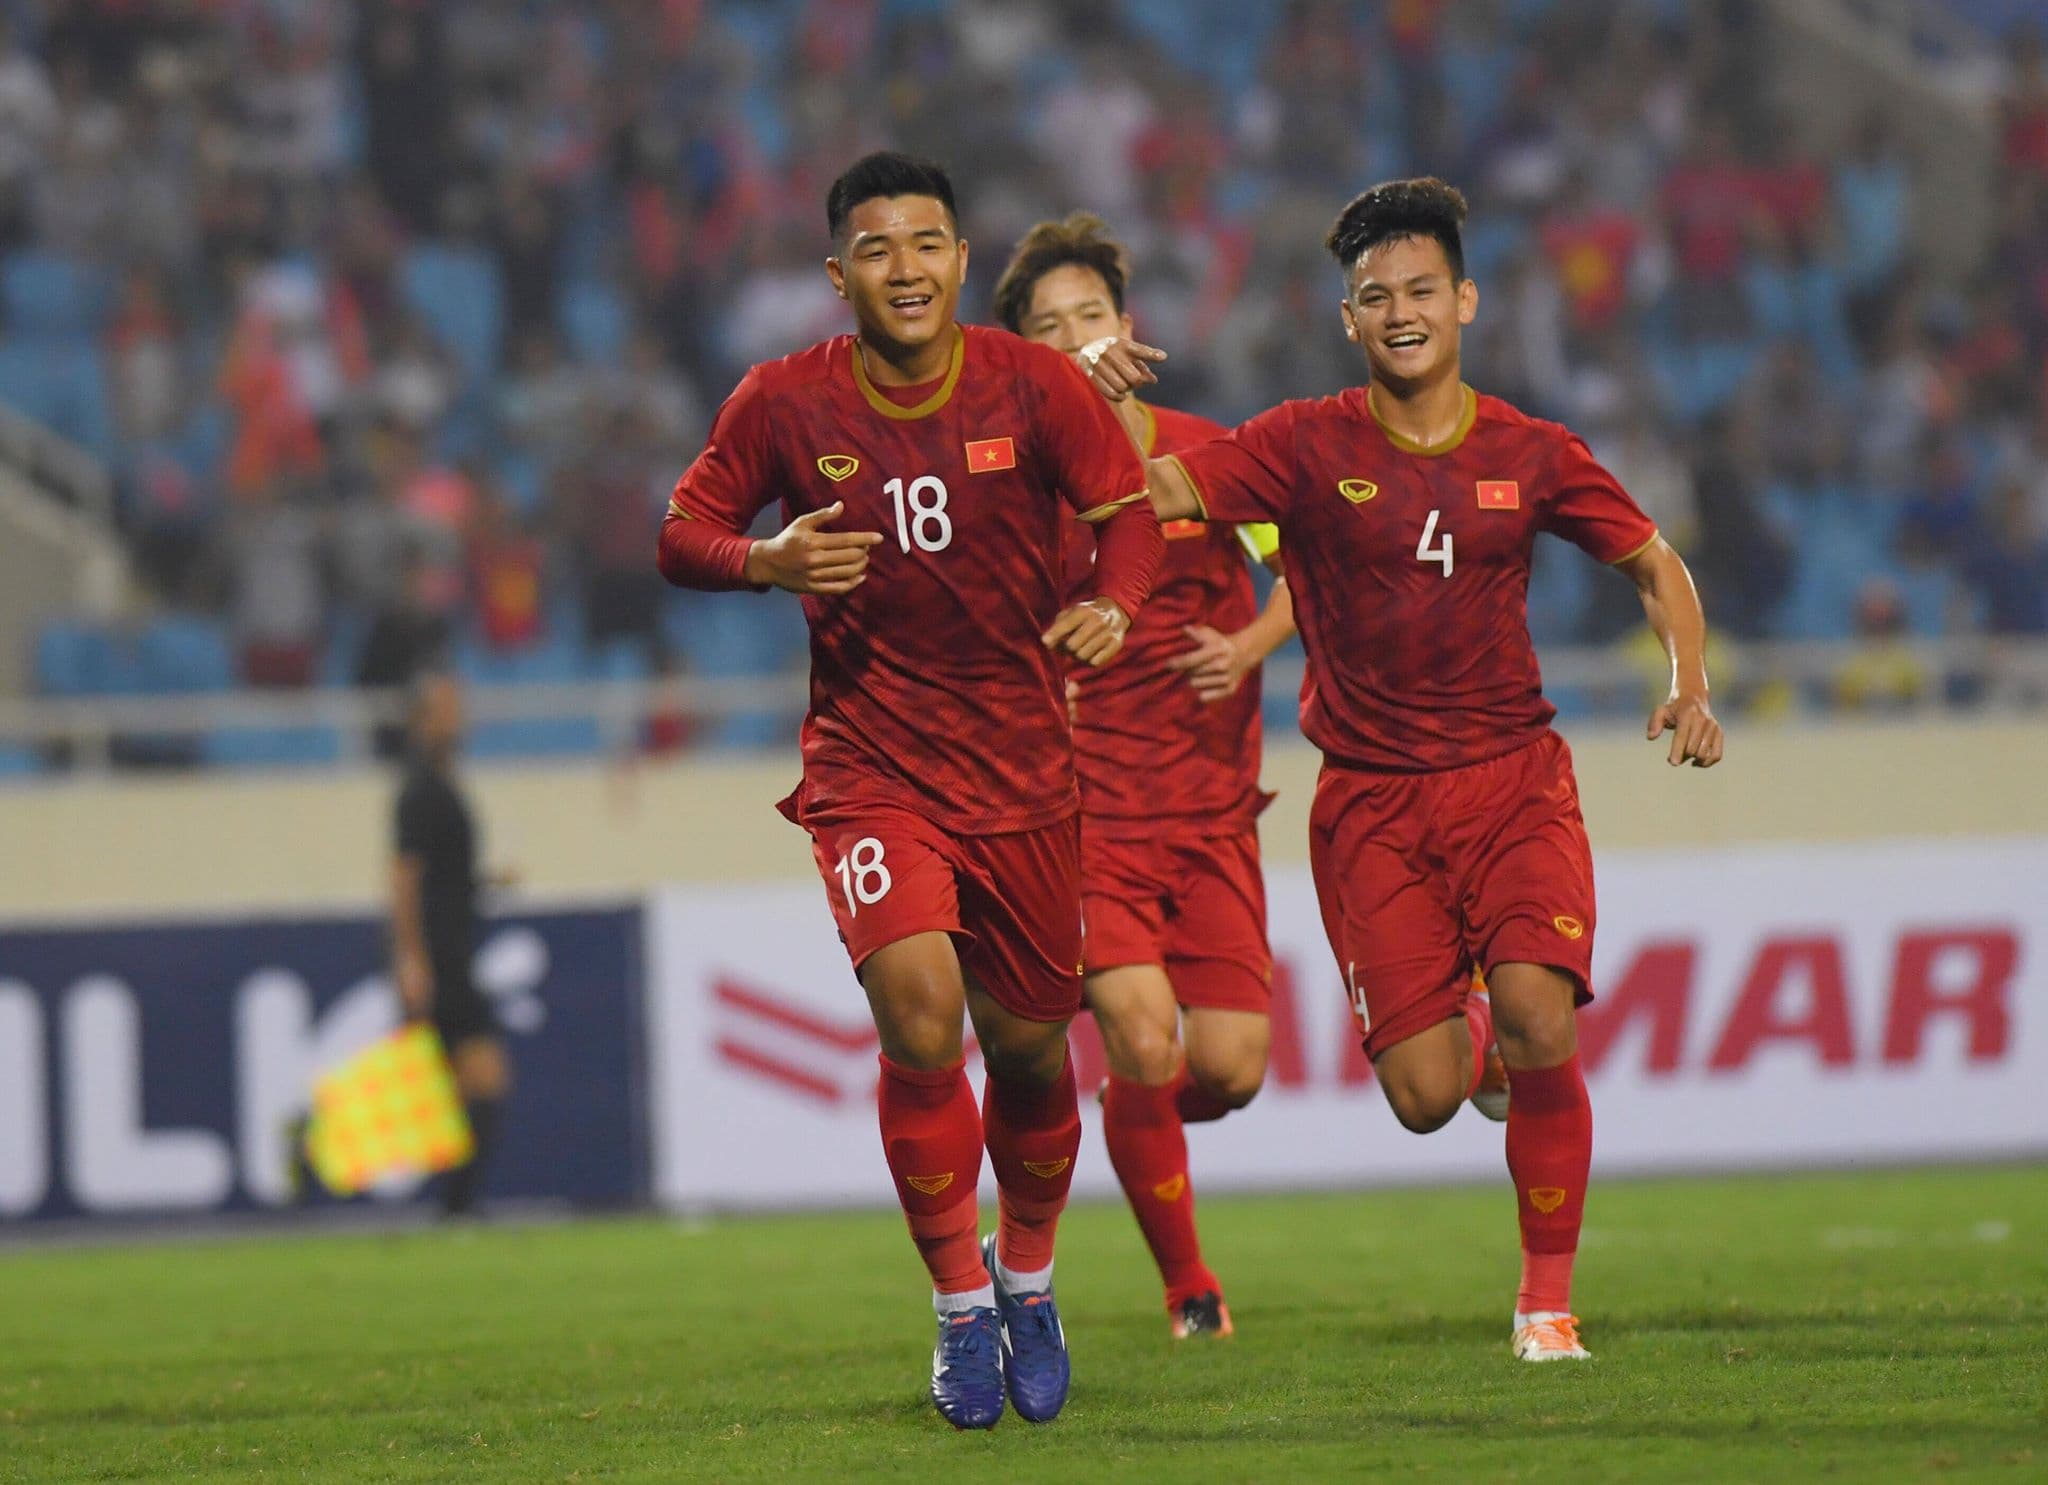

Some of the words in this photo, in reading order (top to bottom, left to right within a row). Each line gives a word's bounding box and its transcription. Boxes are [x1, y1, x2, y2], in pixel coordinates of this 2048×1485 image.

[883, 475, 953, 554] 18
[1416, 509, 1454, 578] 4
[834, 837, 892, 919] 18
